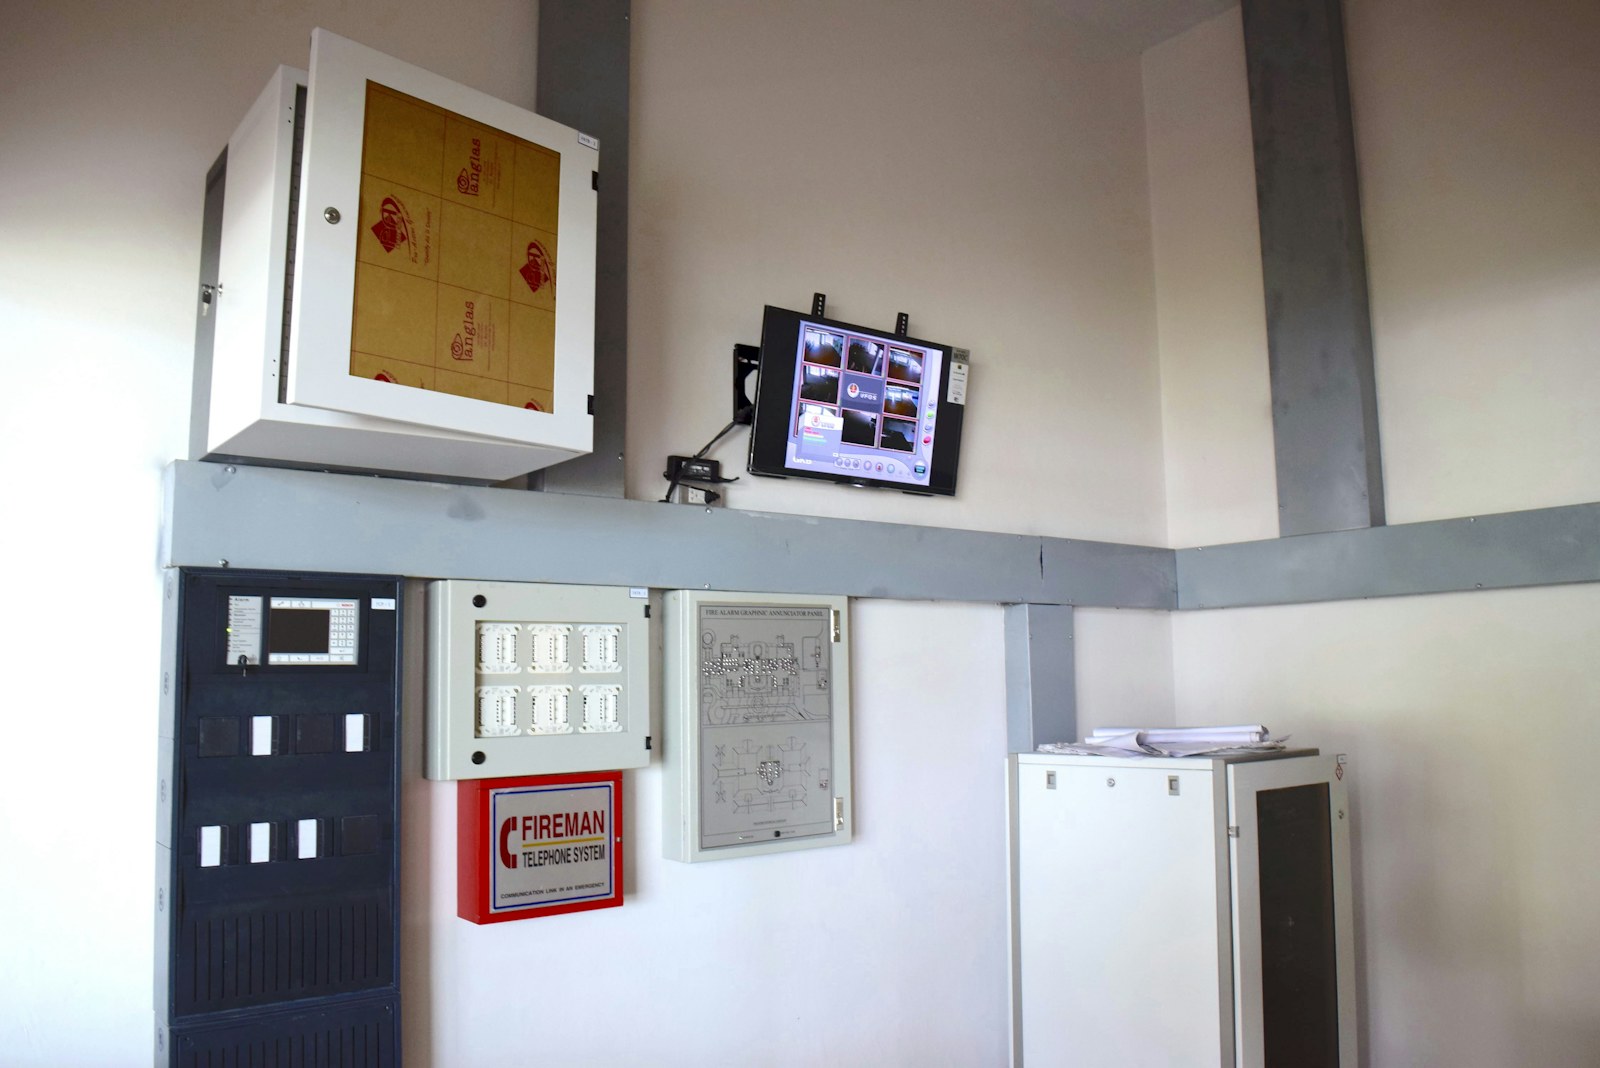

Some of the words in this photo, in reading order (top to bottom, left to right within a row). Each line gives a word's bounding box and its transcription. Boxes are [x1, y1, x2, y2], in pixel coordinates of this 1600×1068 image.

[522, 810, 605, 841] FIREMAN
[522, 847, 572, 868] TELEPHONE
[573, 844, 606, 864] SYSTEM
[500, 889, 544, 899] COMMUNICATION
[574, 882, 605, 891] EMERGENCY
